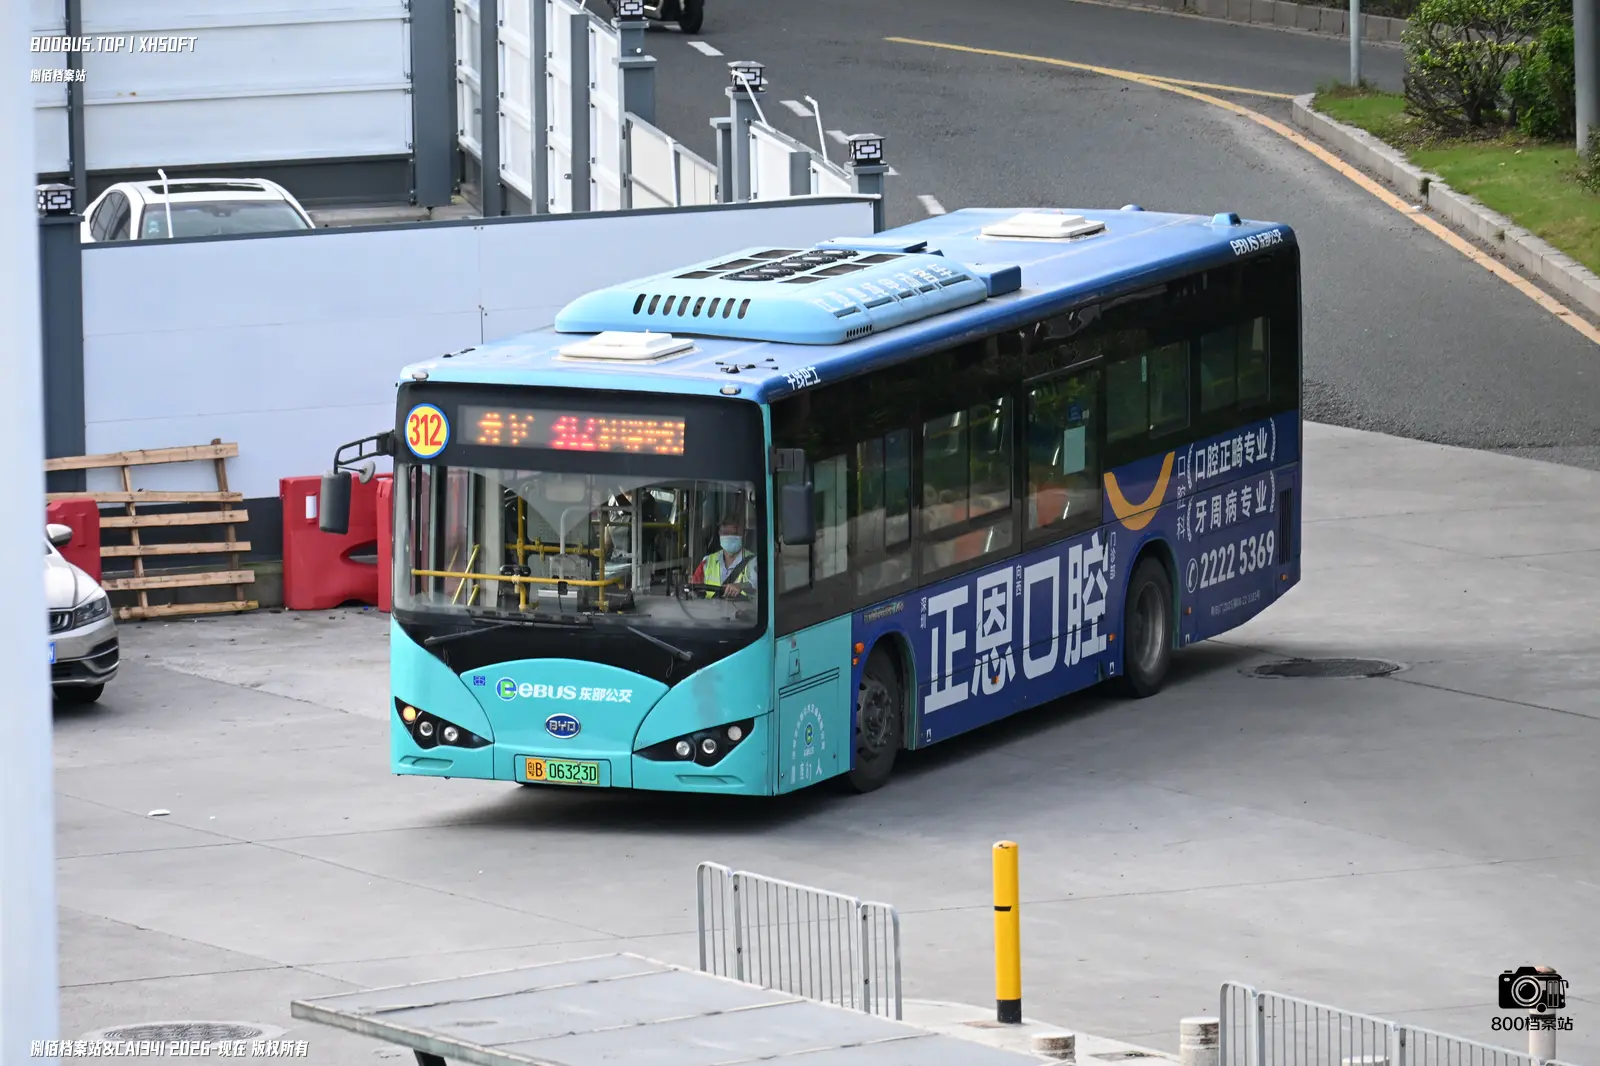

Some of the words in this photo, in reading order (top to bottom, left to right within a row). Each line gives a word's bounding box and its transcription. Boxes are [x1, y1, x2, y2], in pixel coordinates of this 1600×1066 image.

[1229, 235, 1260, 256] eBUS
[409, 413, 442, 446] 312
[1194, 426, 1268, 481] 口腔正畸专业
[1194, 480, 1268, 534] 牙周病专业
[1200, 542, 1236, 590] 2222
[1238, 529, 1275, 576] 5369
[924, 531, 1109, 715] 正恩口腔
[518, 682, 577, 700] eBUS
[578, 686, 633, 703] 东部公交
[548, 719, 577, 733] BYD
[548, 764, 598, 782] 06323D
